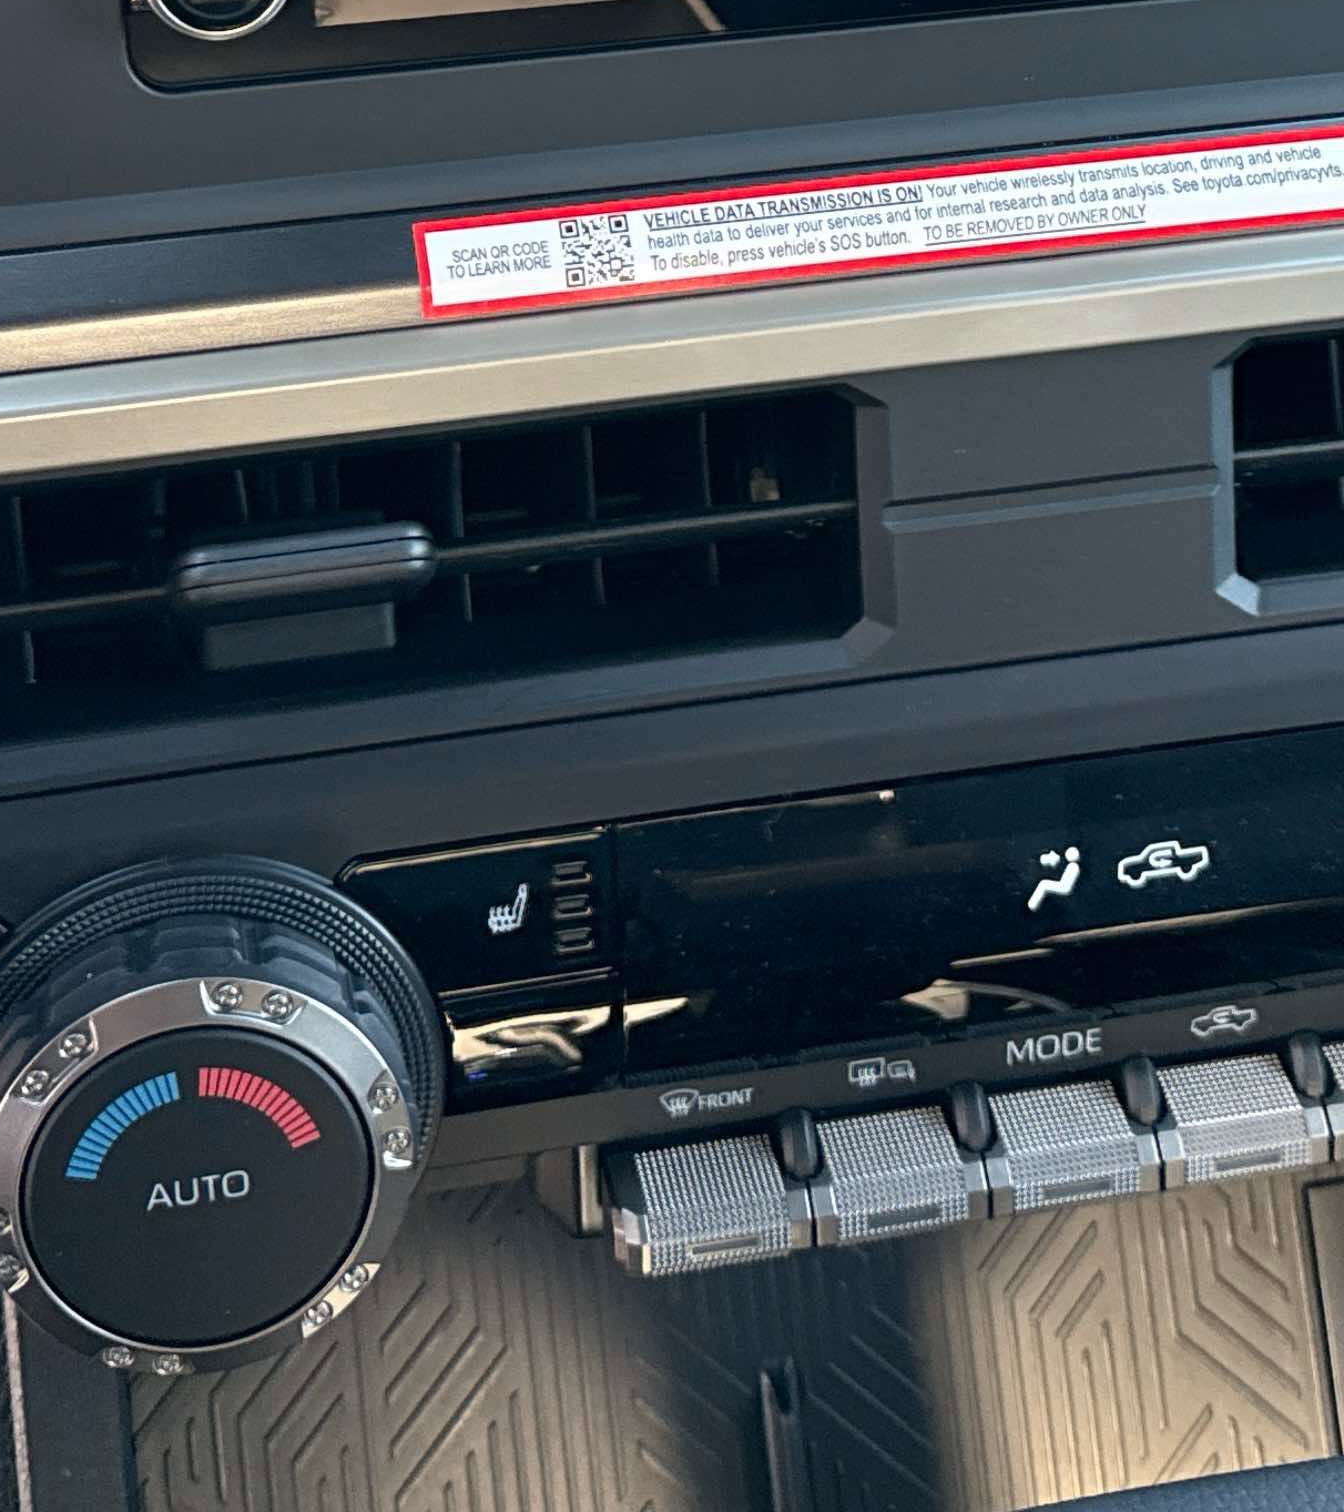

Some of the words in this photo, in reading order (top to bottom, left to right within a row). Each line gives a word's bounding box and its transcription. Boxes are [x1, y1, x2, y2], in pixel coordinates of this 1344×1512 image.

[644, 208, 711, 229] VEHICLE
[714, 203, 755, 222] DATA
[757, 191, 874, 216] TRANSMISSION
[878, 188, 892, 203] IS
[896, 184, 923, 201] ON!
[927, 183, 956, 198] Your
[960, 178, 1007, 194] vehicle
[1011, 170, 1075, 189] wirelessly
[1078, 163, 1139, 183] transmits
[1141, 159, 1198, 177] location,
[1201, 155, 1244, 171] driving
[1248, 151, 1273, 165] and
[1275, 146, 1321, 163] vehicle
[648, 233, 690, 250] health
[693, 230, 724, 245] data
[727, 227, 741, 240] to
[745, 222, 789, 238] deliver
[794, 219, 823, 237] your
[828, 213, 882, 230] services
[886, 209, 911, 223] and
[914, 206, 934, 220] for
[937, 199, 986, 217] internal
[989, 194, 1047, 212] research
[1051, 190, 1076, 206] and
[1079, 187, 1108, 203] data
[1112, 182, 1169, 201] analysis.
[1172, 177, 1199, 194] See
[452, 247, 487, 263] SCAN
[490, 244, 509, 258] QR
[512, 240, 549, 256] CODE
[650, 255, 667, 271] To
[671, 249, 724, 269] disable,
[728, 247, 765, 268] press
[768, 238, 826, 258] vehicle's
[830, 233, 862, 251] SOS
[865, 230, 912, 247] button.
[923, 226, 942, 240] TO
[946, 223, 963, 237] BE
[967, 214, 1034, 236] REMOVED
[1037, 213, 1055, 229] BY
[1058, 207, 1109, 226] OWNER
[1112, 204, 1146, 222] ONLY
[447, 265, 465, 279] TO
[468, 260, 510, 277] LEARN
[513, 255, 552, 272] MORE
[1006, 1027, 1103, 1066] MODE
[697, 1087, 754, 1111] FRONT
[146, 1169, 251, 1212] AUTO
